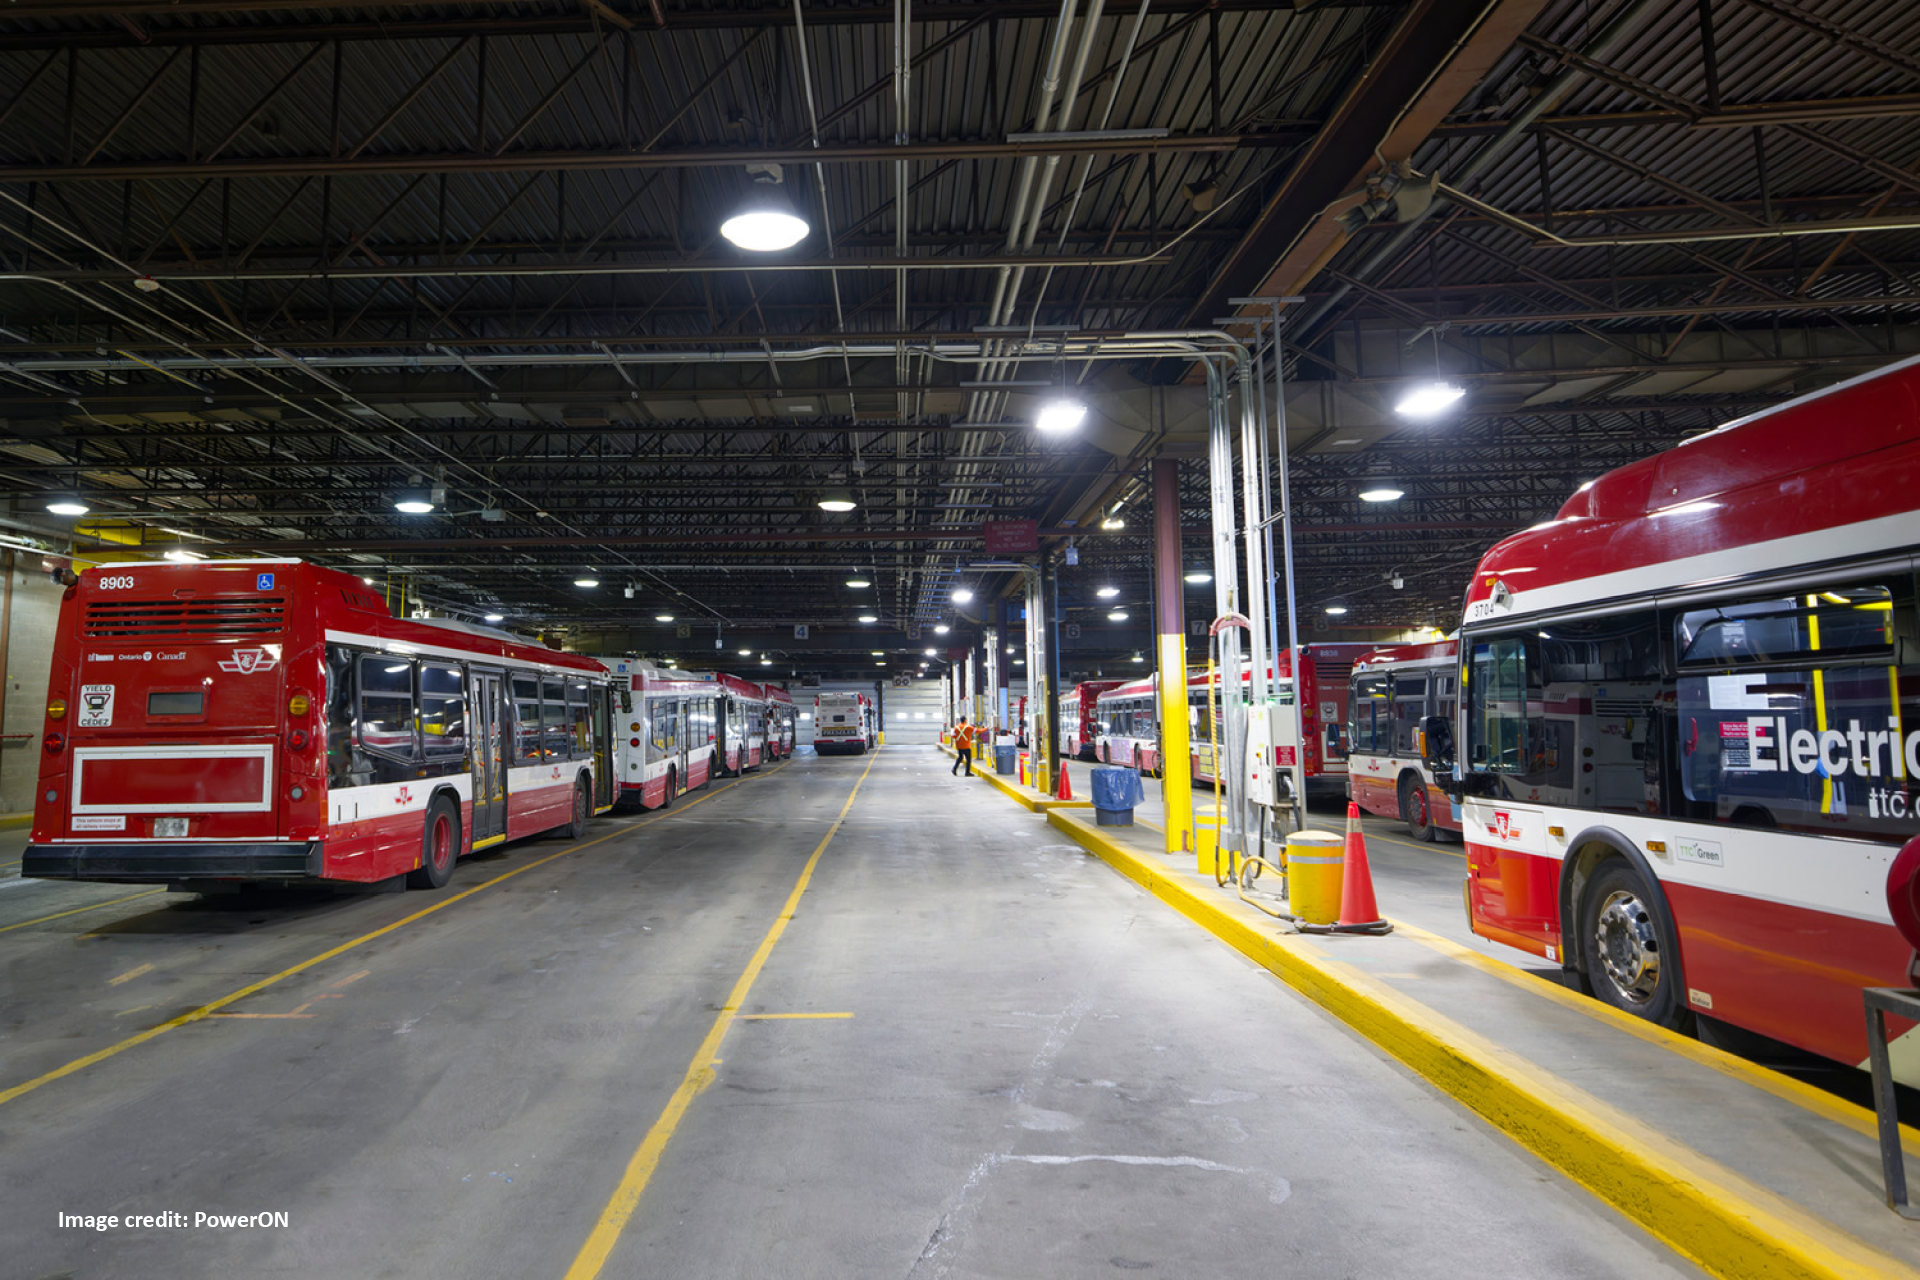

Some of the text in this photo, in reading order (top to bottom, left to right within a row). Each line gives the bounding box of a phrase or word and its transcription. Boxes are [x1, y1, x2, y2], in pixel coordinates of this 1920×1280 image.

[99, 575, 134, 590] 8903
[1474, 603, 1495, 618] 3704
[1445, 614, 1455, 627] 9
[570, 625, 578, 636] 2
[680, 625, 687, 636] 3
[797, 625, 806, 637] 4
[910, 626, 919, 637] 5
[1069, 625, 1079, 637] 6
[1194, 621, 1203, 634] 7
[81, 718, 110, 726] CÉDEZ
[1869, 787, 1920, 819] ttc.
[1679, 845, 1720, 860] TTC Green
